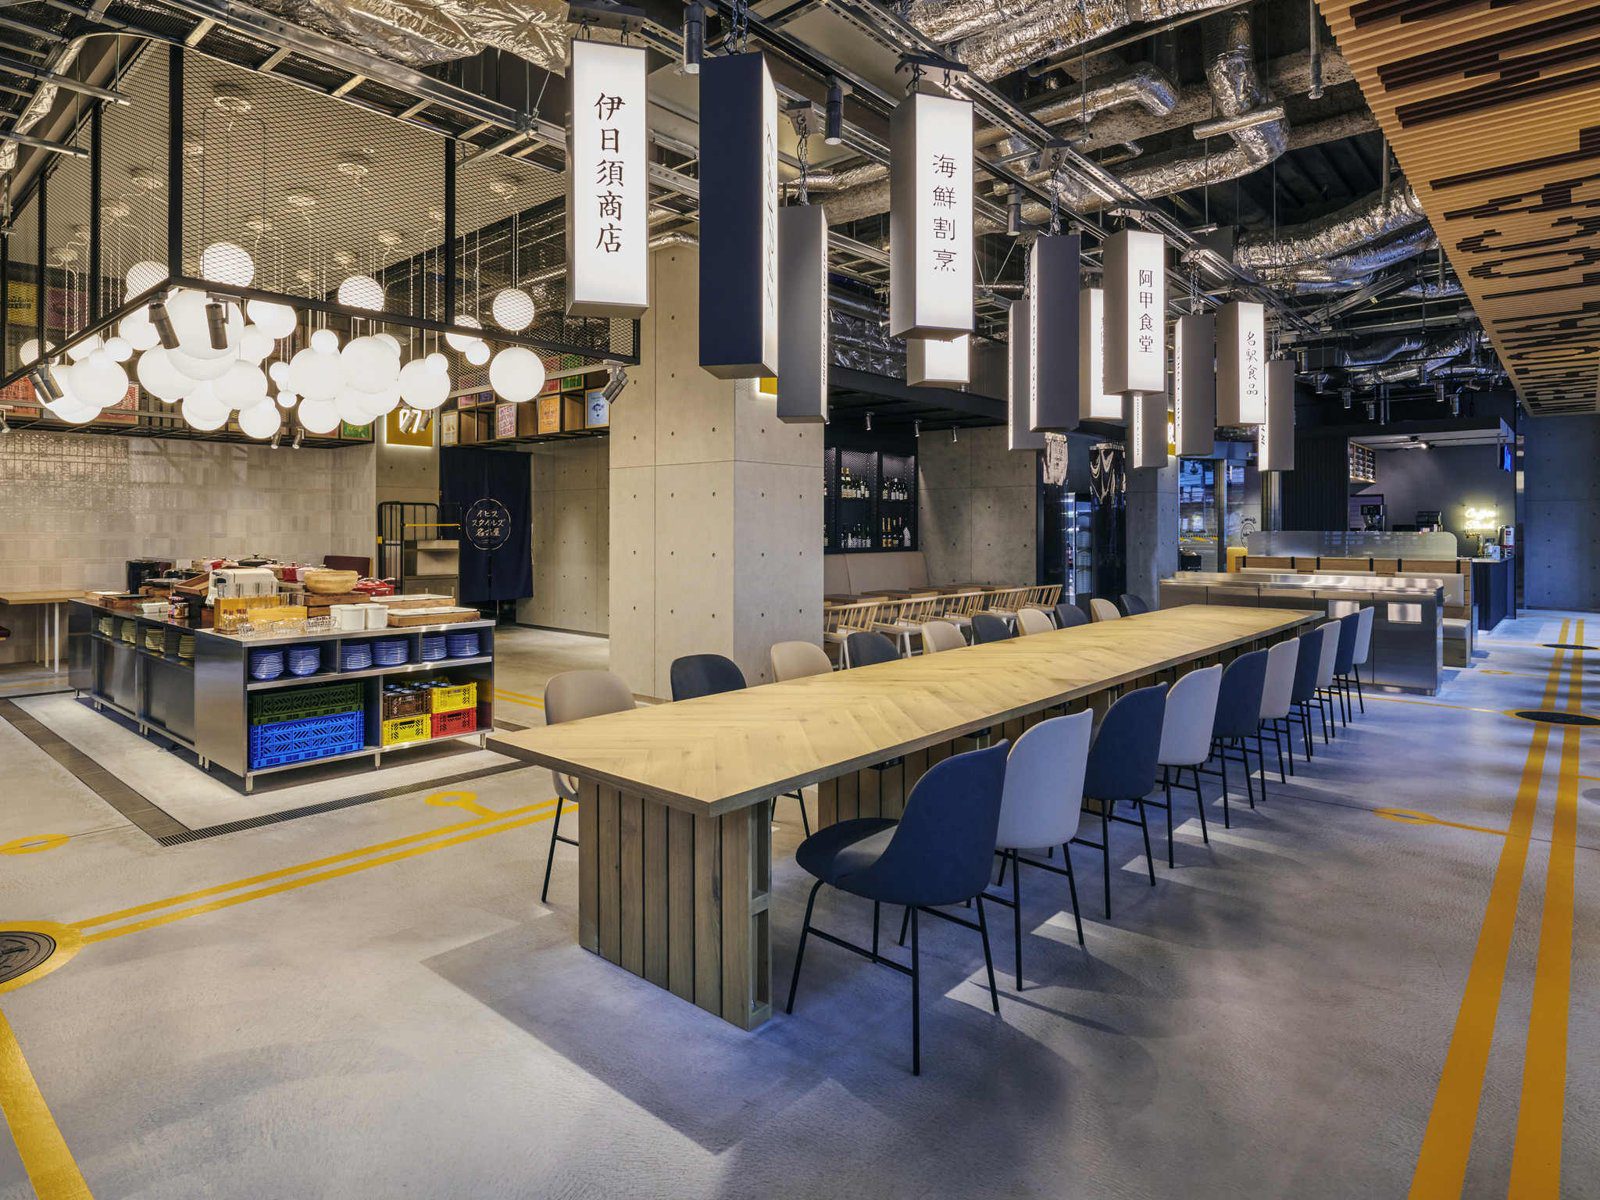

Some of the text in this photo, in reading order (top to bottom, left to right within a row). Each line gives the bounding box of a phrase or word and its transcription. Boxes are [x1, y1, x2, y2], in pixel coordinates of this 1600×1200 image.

[593, 92, 626, 254] 伊日須商店
[932, 153, 957, 272] 海鮮割烹
[1138, 269, 1154, 353] 阿甲食堂
